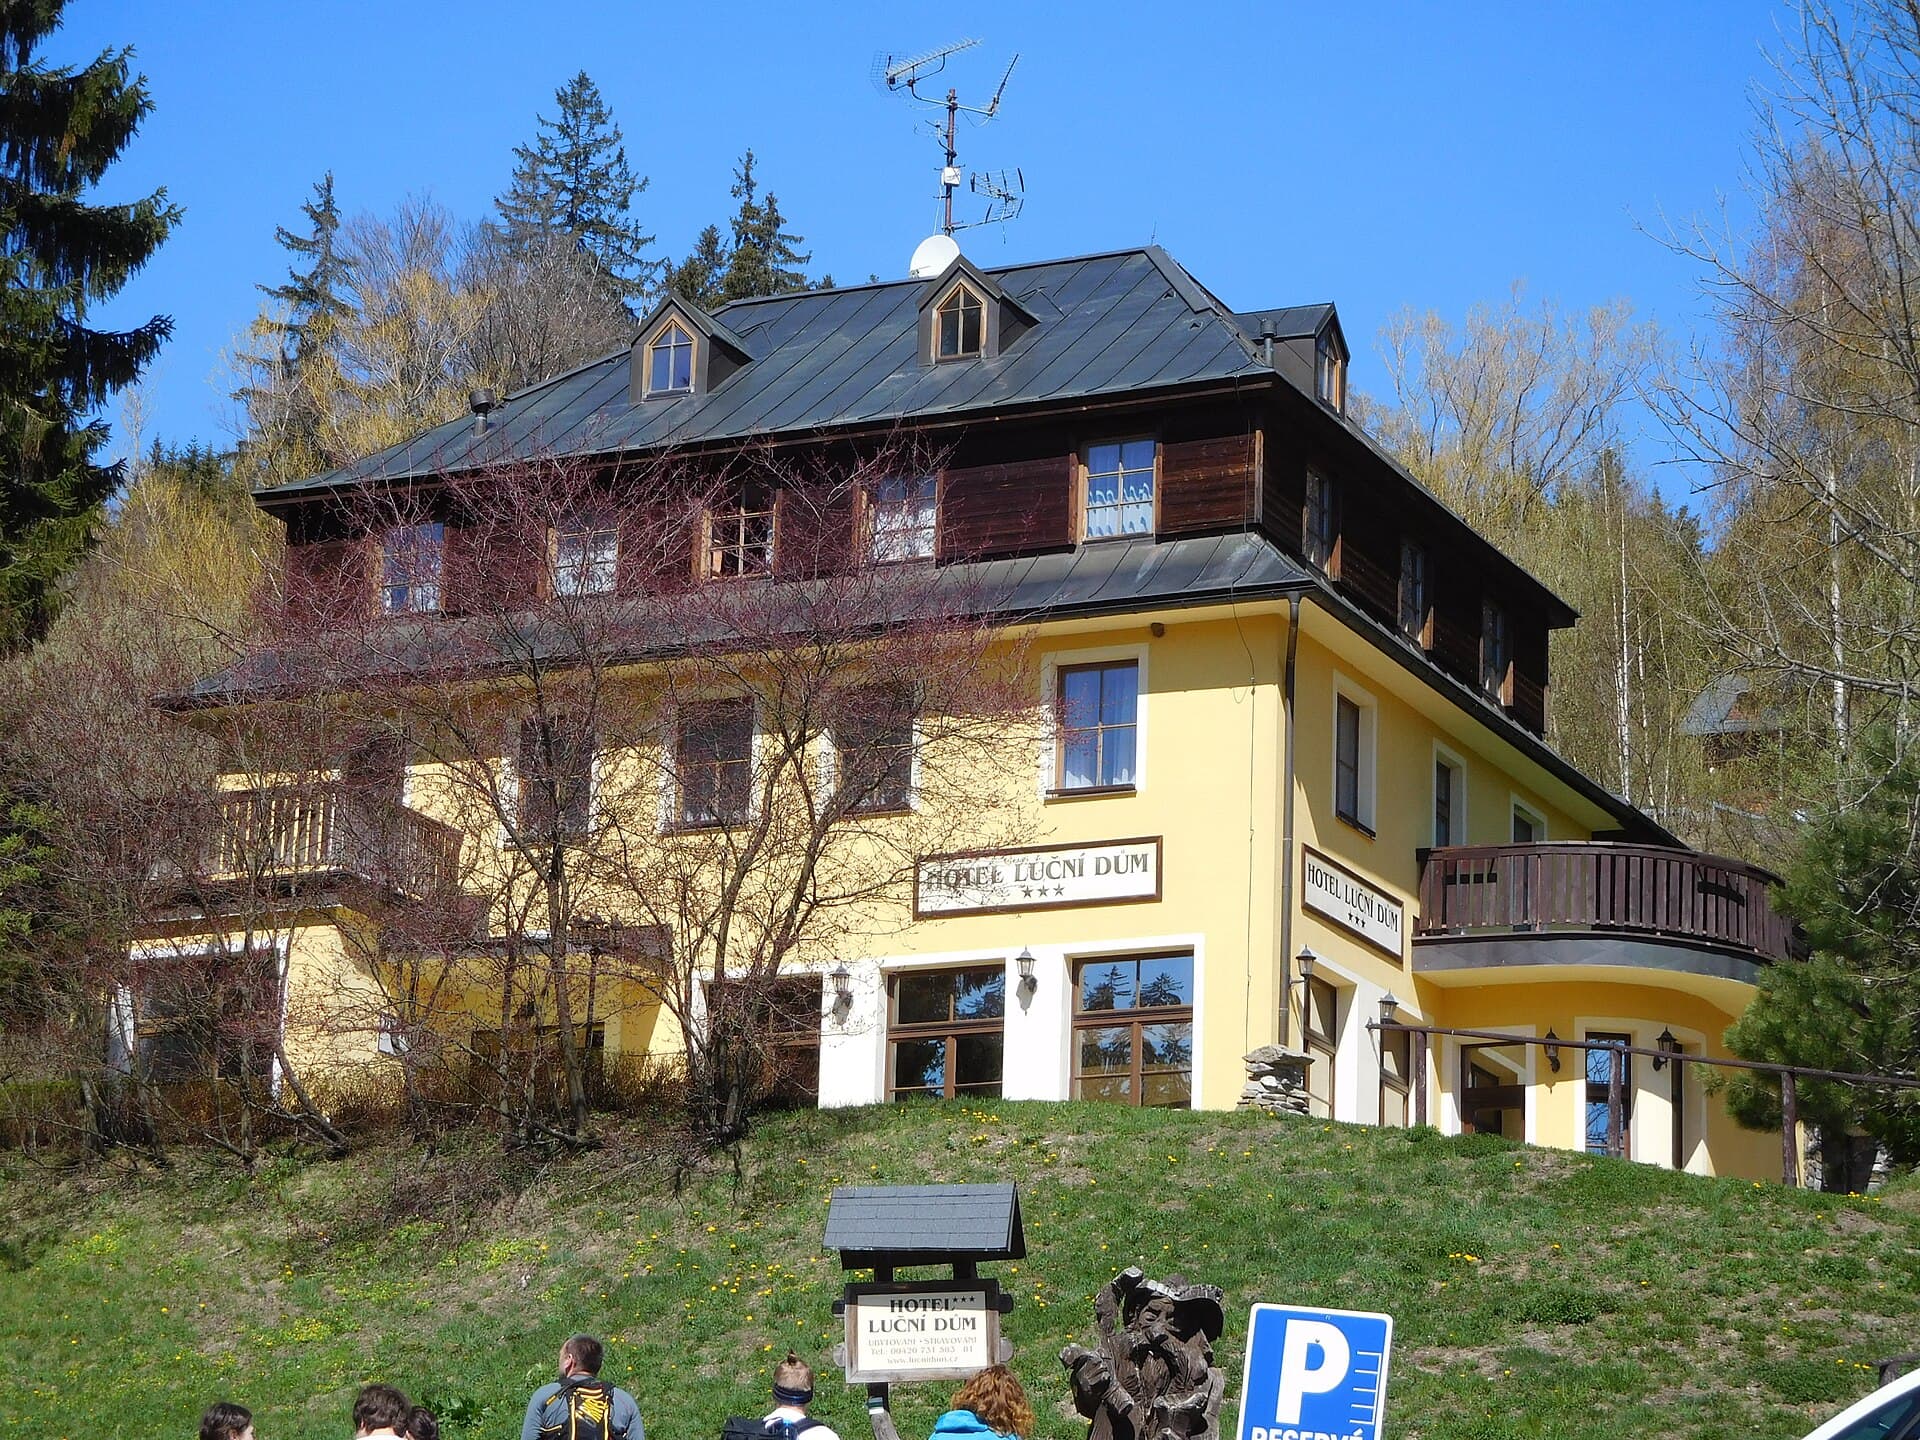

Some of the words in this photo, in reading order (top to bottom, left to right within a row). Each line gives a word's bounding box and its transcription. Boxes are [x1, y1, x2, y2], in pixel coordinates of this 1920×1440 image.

[927, 865, 1003, 890] HOTEL
[1014, 852, 1085, 882] LUČNÍ
[1094, 848, 1149, 876] DŮM
[1307, 862, 1341, 899] HOTEL
[1344, 883, 1374, 918] LUČNÍ
[1377, 903, 1398, 932] DŮM
[868, 1314, 926, 1333] LUČNÍ
[934, 1313, 977, 1331] DŮM
[890, 1298, 955, 1312] HOTEL
[1276, 1319, 1350, 1425] P
